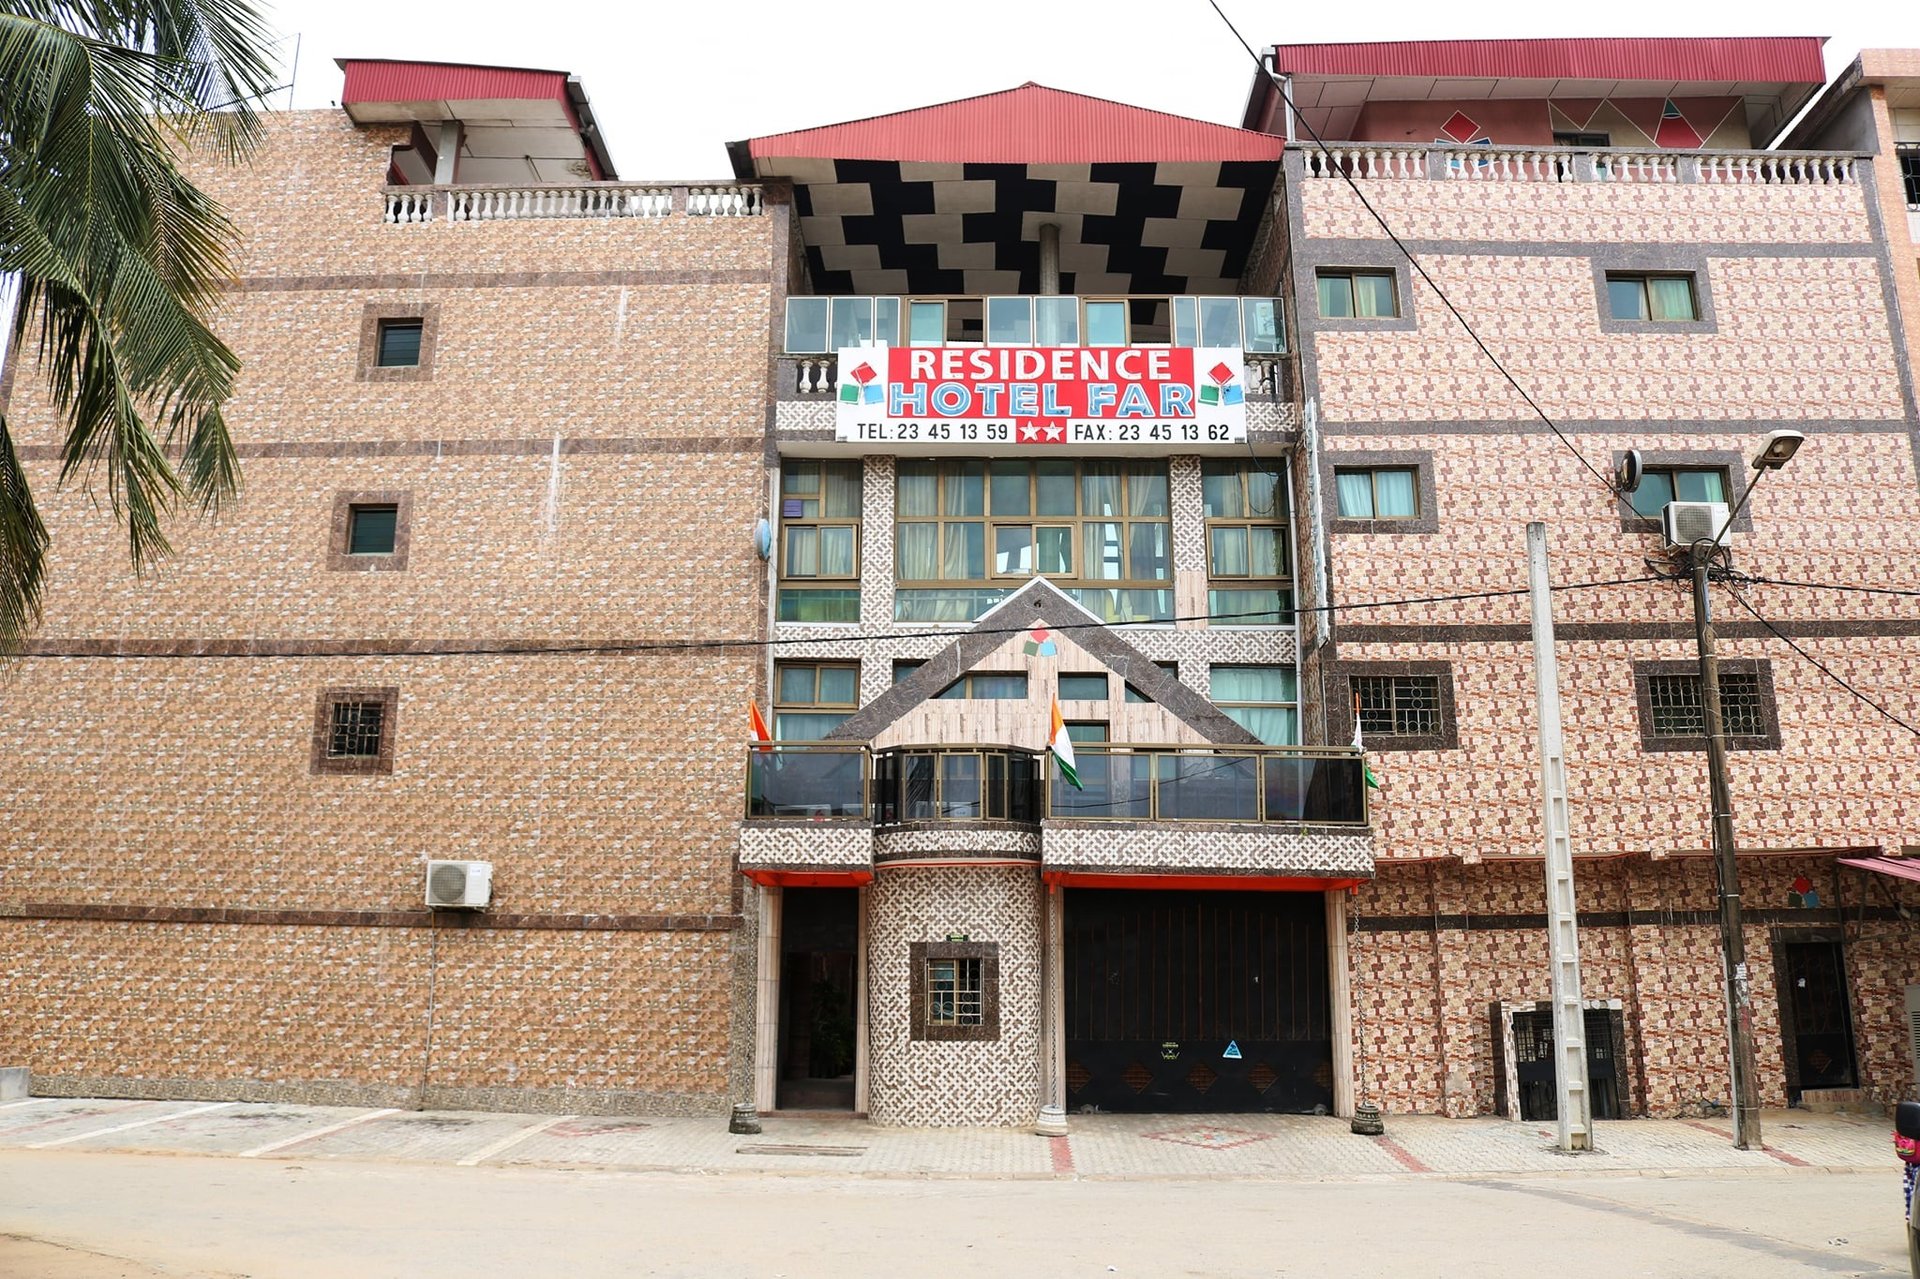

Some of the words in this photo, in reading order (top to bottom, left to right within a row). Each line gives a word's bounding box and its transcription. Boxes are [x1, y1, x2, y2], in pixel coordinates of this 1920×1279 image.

[910, 350, 1171, 380] RESIDENCE
[888, 382, 1072, 416] HOTEL
[1087, 382, 1194, 417] FAR
[857, 424, 894, 440] TEL:
[897, 424, 919, 440] 23
[928, 423, 951, 440] 45
[960, 424, 978, 440] 13
[986, 423, 1009, 440] 59
[1074, 424, 1112, 440] FAX:
[1118, 424, 1140, 440] 23
[1149, 424, 1172, 440] 45
[1181, 424, 1199, 440] 13
[1208, 424, 1230, 440] 62
